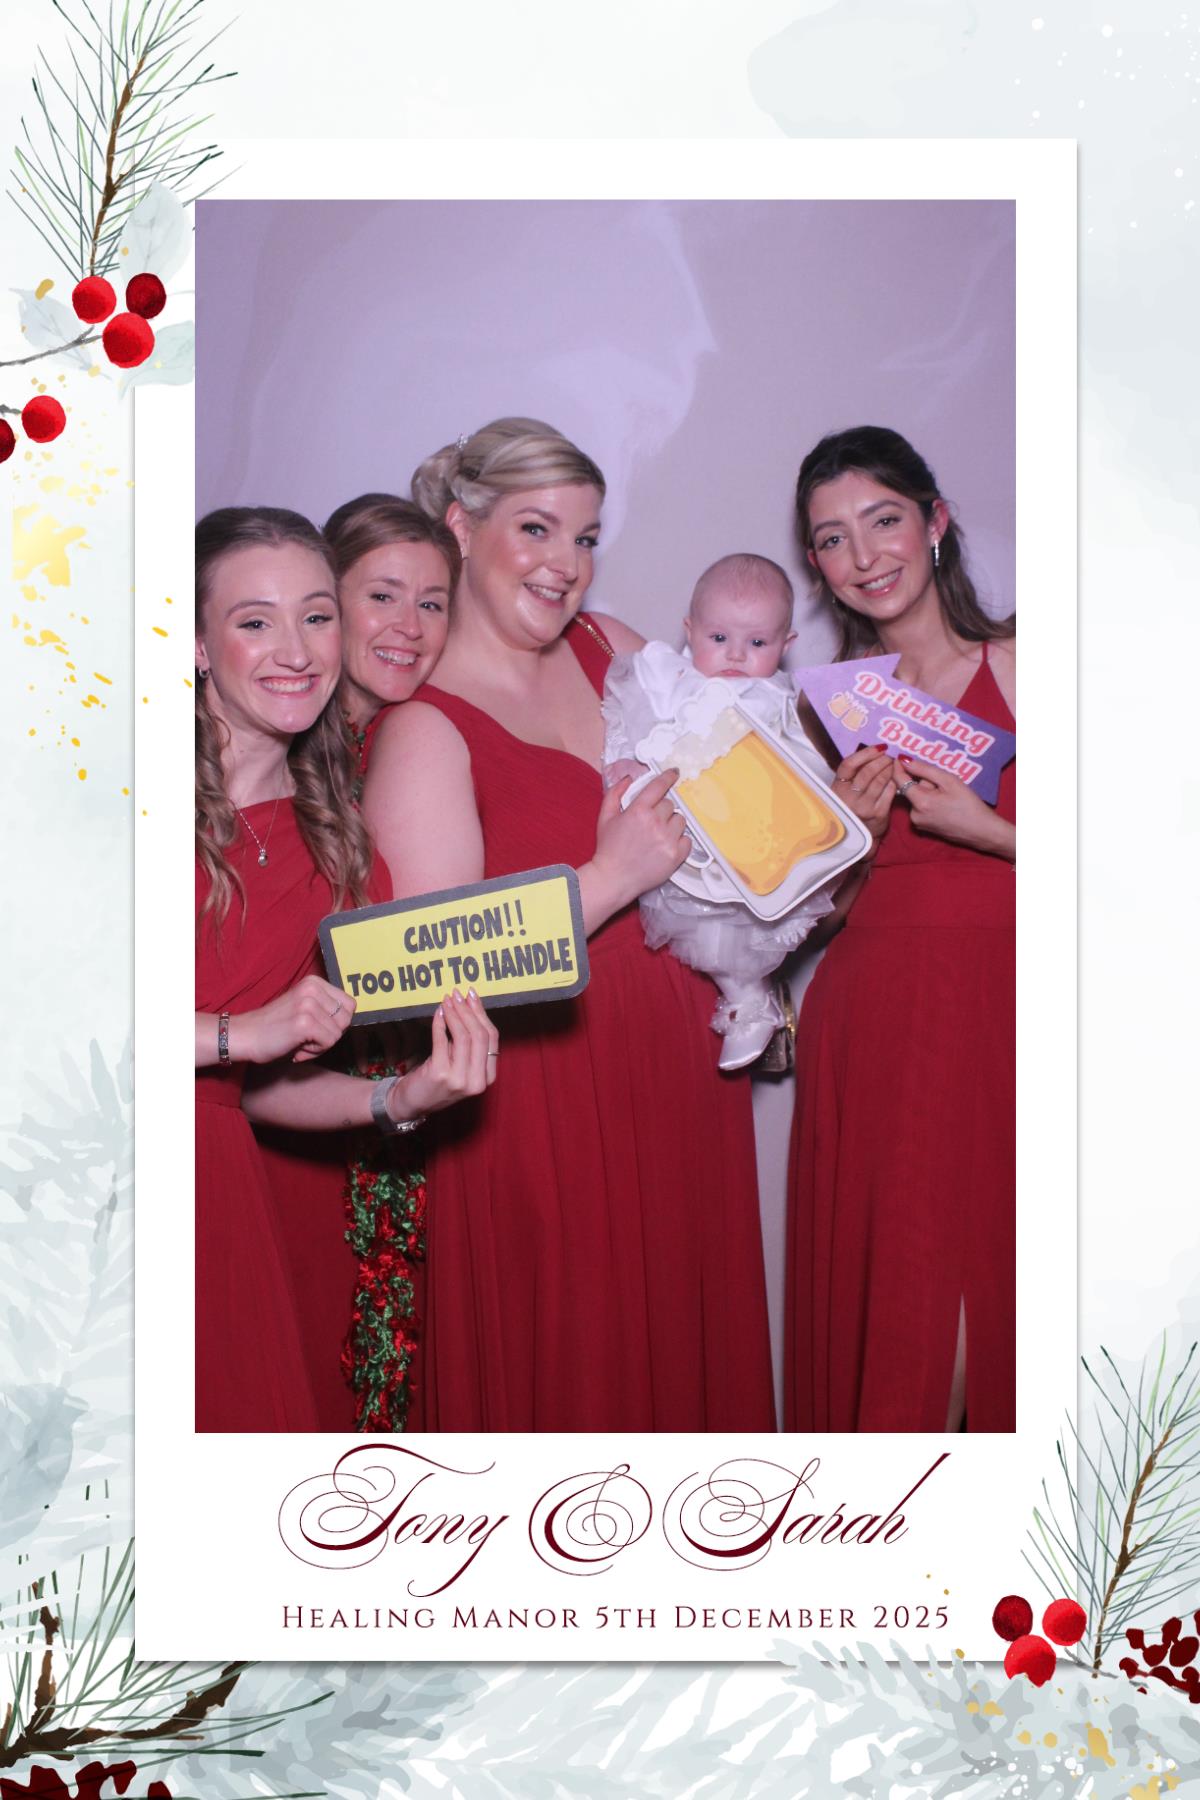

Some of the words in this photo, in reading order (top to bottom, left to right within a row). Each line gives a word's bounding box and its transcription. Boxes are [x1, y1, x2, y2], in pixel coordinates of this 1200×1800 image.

[852, 672, 994, 756] Drinking
[878, 718, 982, 784] Buddy
[403, 899, 527, 954] CAUTION!!
[347, 970, 395, 997] TOO
[400, 959, 444, 992] HOT
[448, 955, 480, 985] TO
[483, 937, 573, 981] HANDLE
